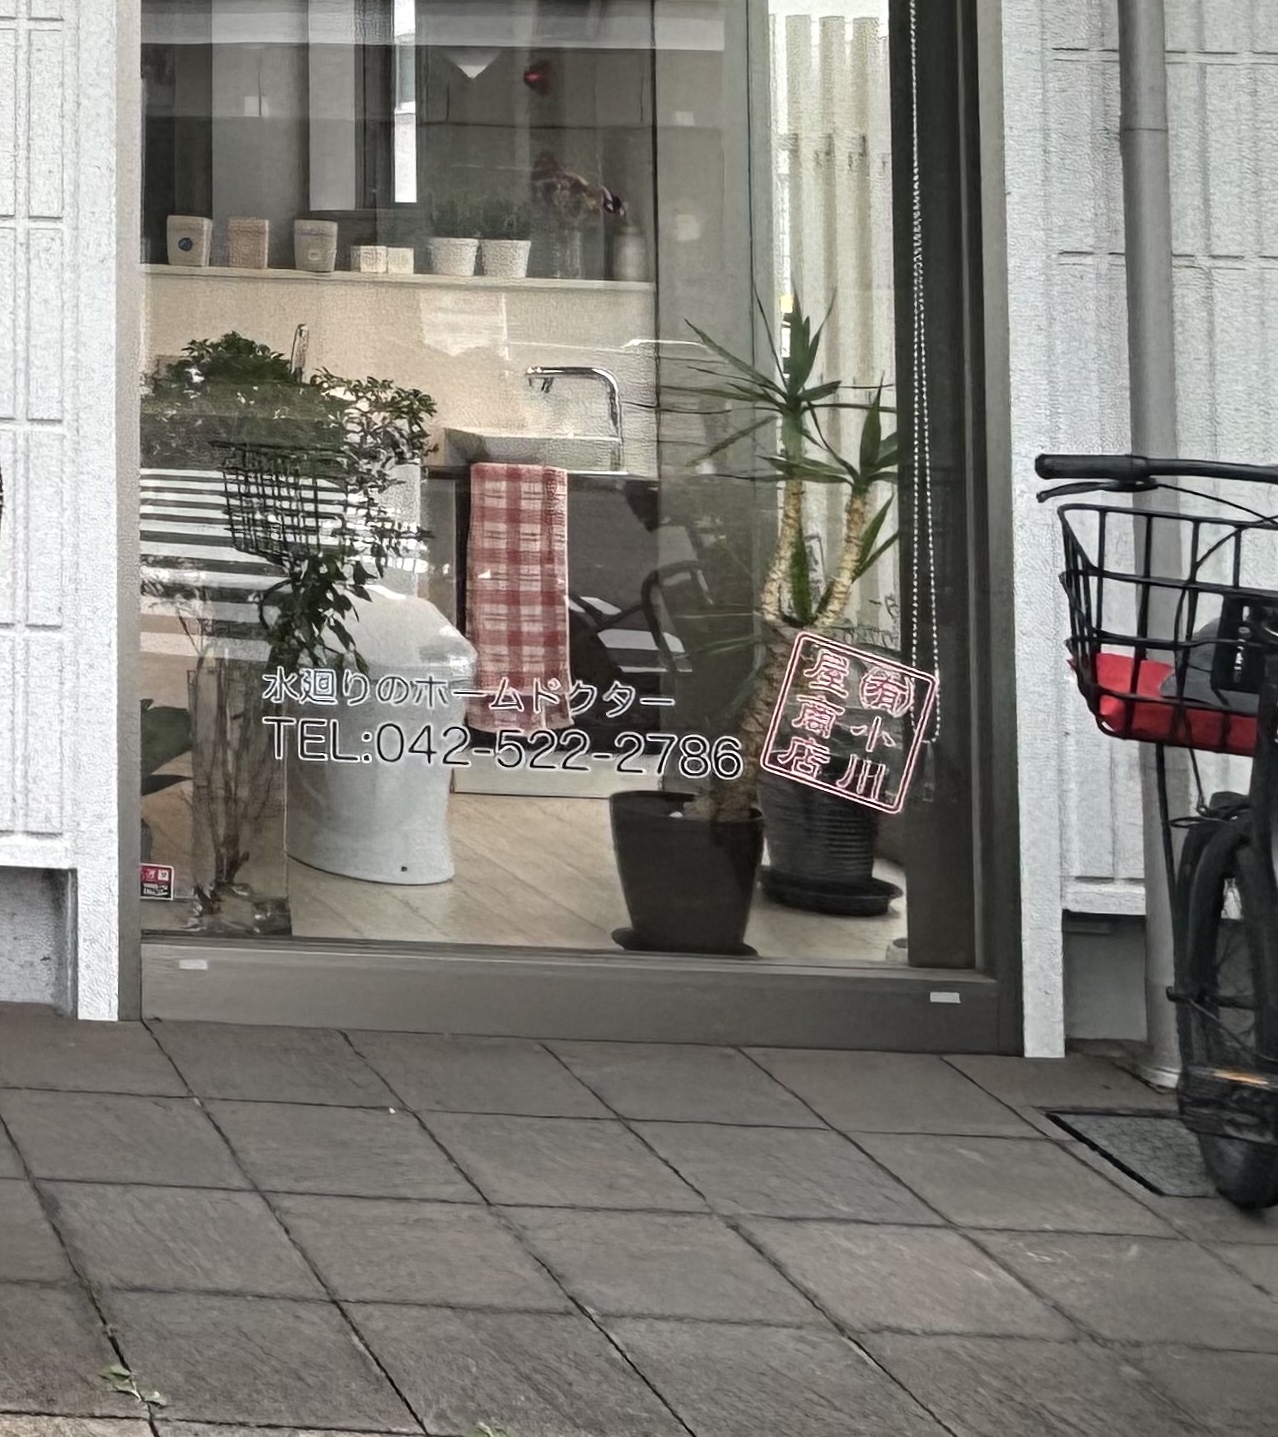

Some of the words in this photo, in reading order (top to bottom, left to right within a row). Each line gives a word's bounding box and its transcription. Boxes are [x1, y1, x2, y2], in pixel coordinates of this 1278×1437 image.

[261, 665, 676, 719] 水廻りのホームドクター
[261, 716, 744, 781] TEL:042-522-2786
